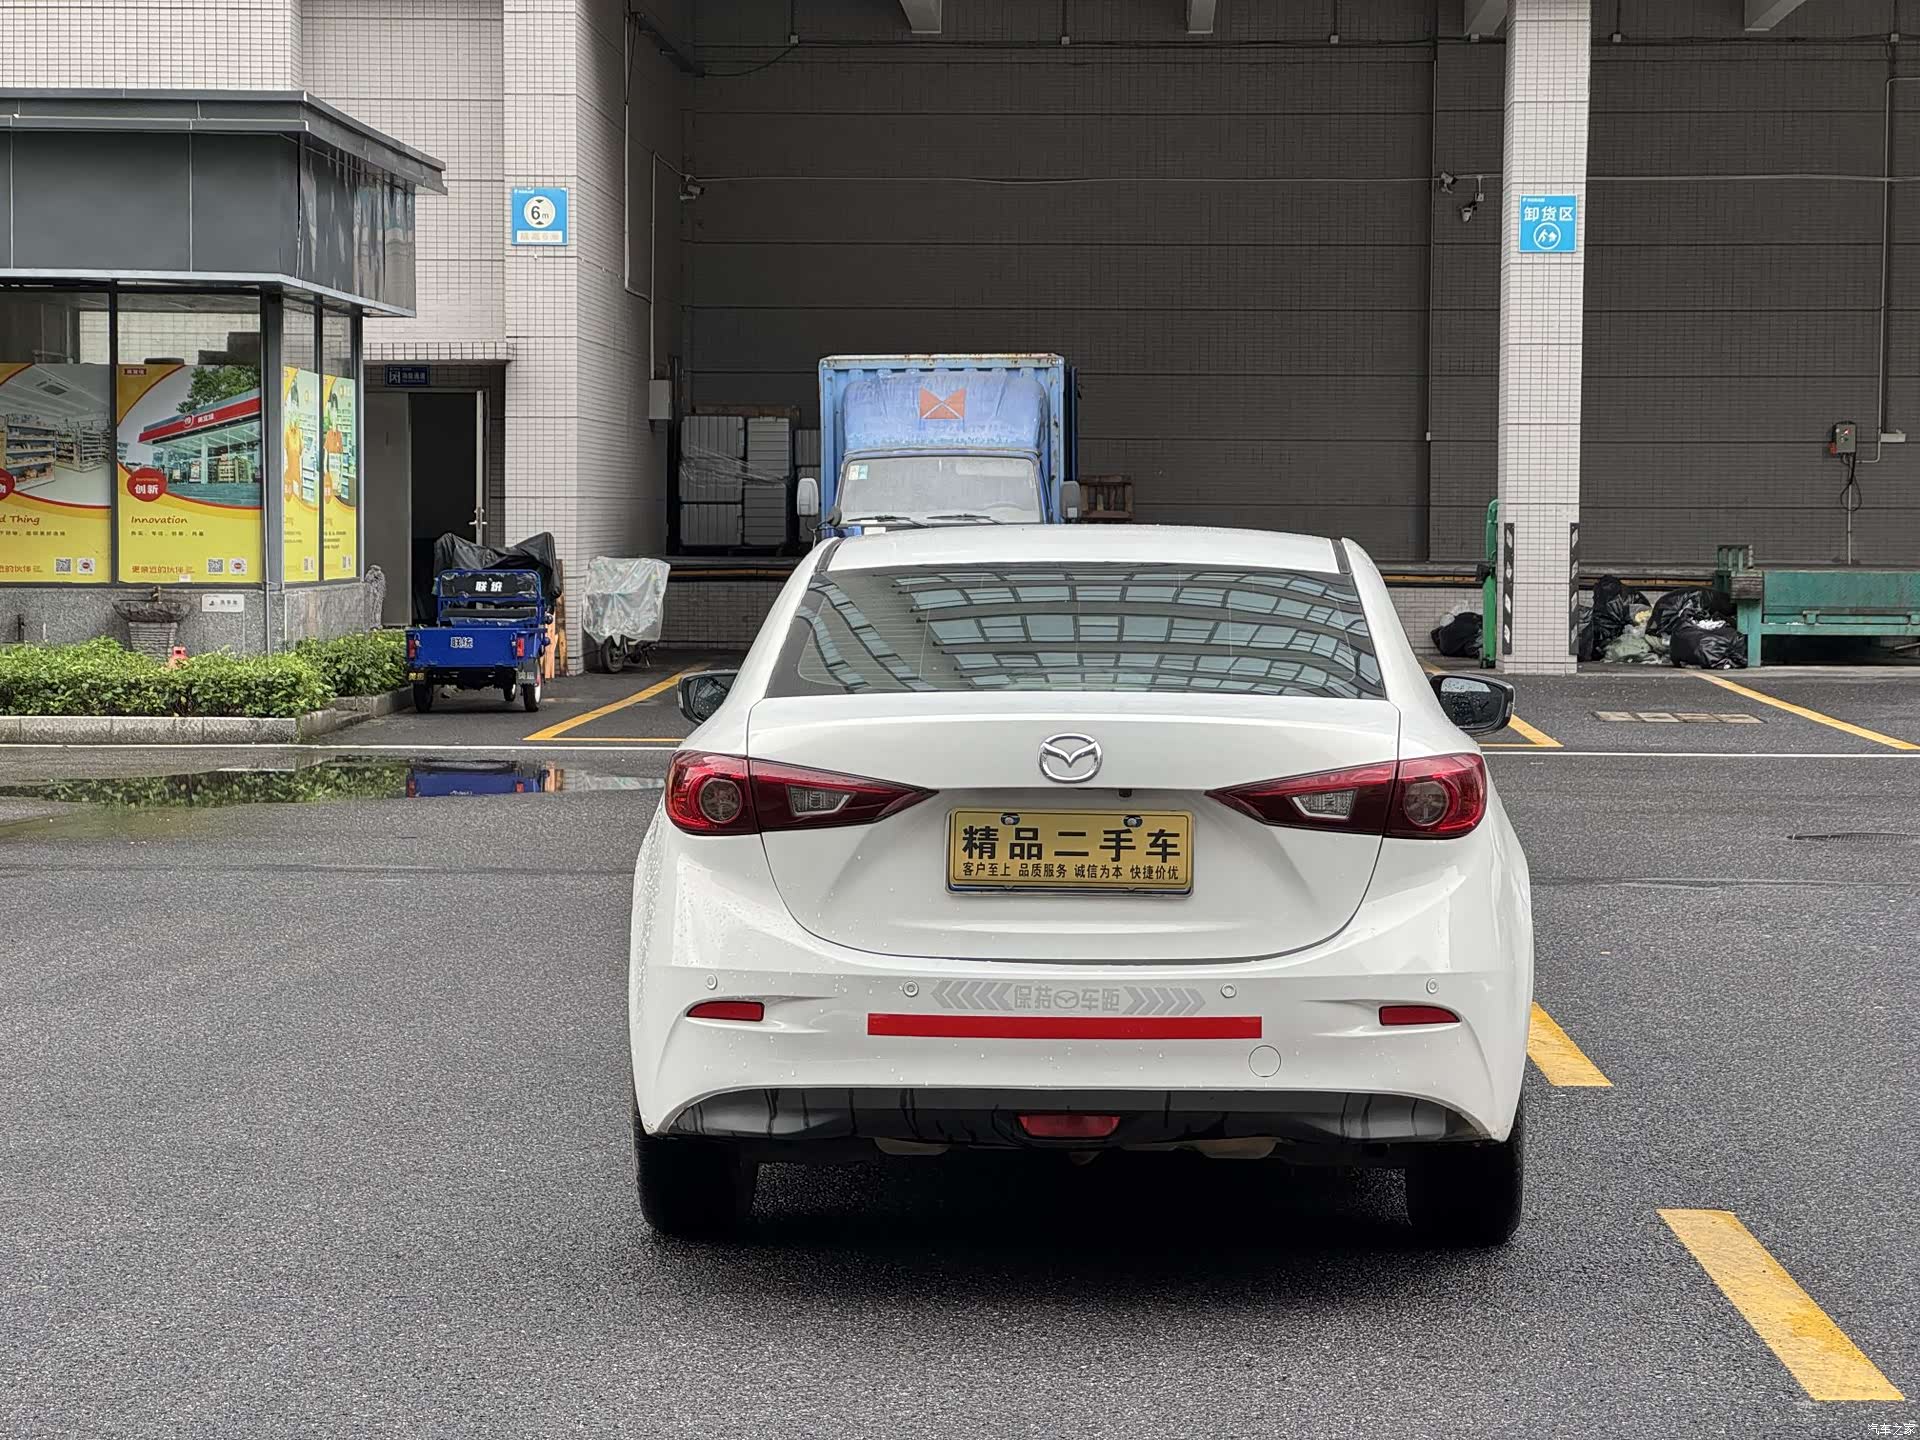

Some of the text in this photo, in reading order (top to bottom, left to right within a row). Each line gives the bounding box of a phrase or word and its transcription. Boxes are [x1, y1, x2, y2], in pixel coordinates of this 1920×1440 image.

[1523, 205, 1574, 222] 卸货区
[134, 483, 159, 495] 创新
[10, 514, 40, 525] Thing
[131, 515, 188, 524] Innovation
[961, 825, 1181, 864] 精品二手车
[962, 862, 1180, 881] 客户至上 品质服务 诚信为本 快捷价优
[1014, 983, 1120, 1011] 保持 车距
